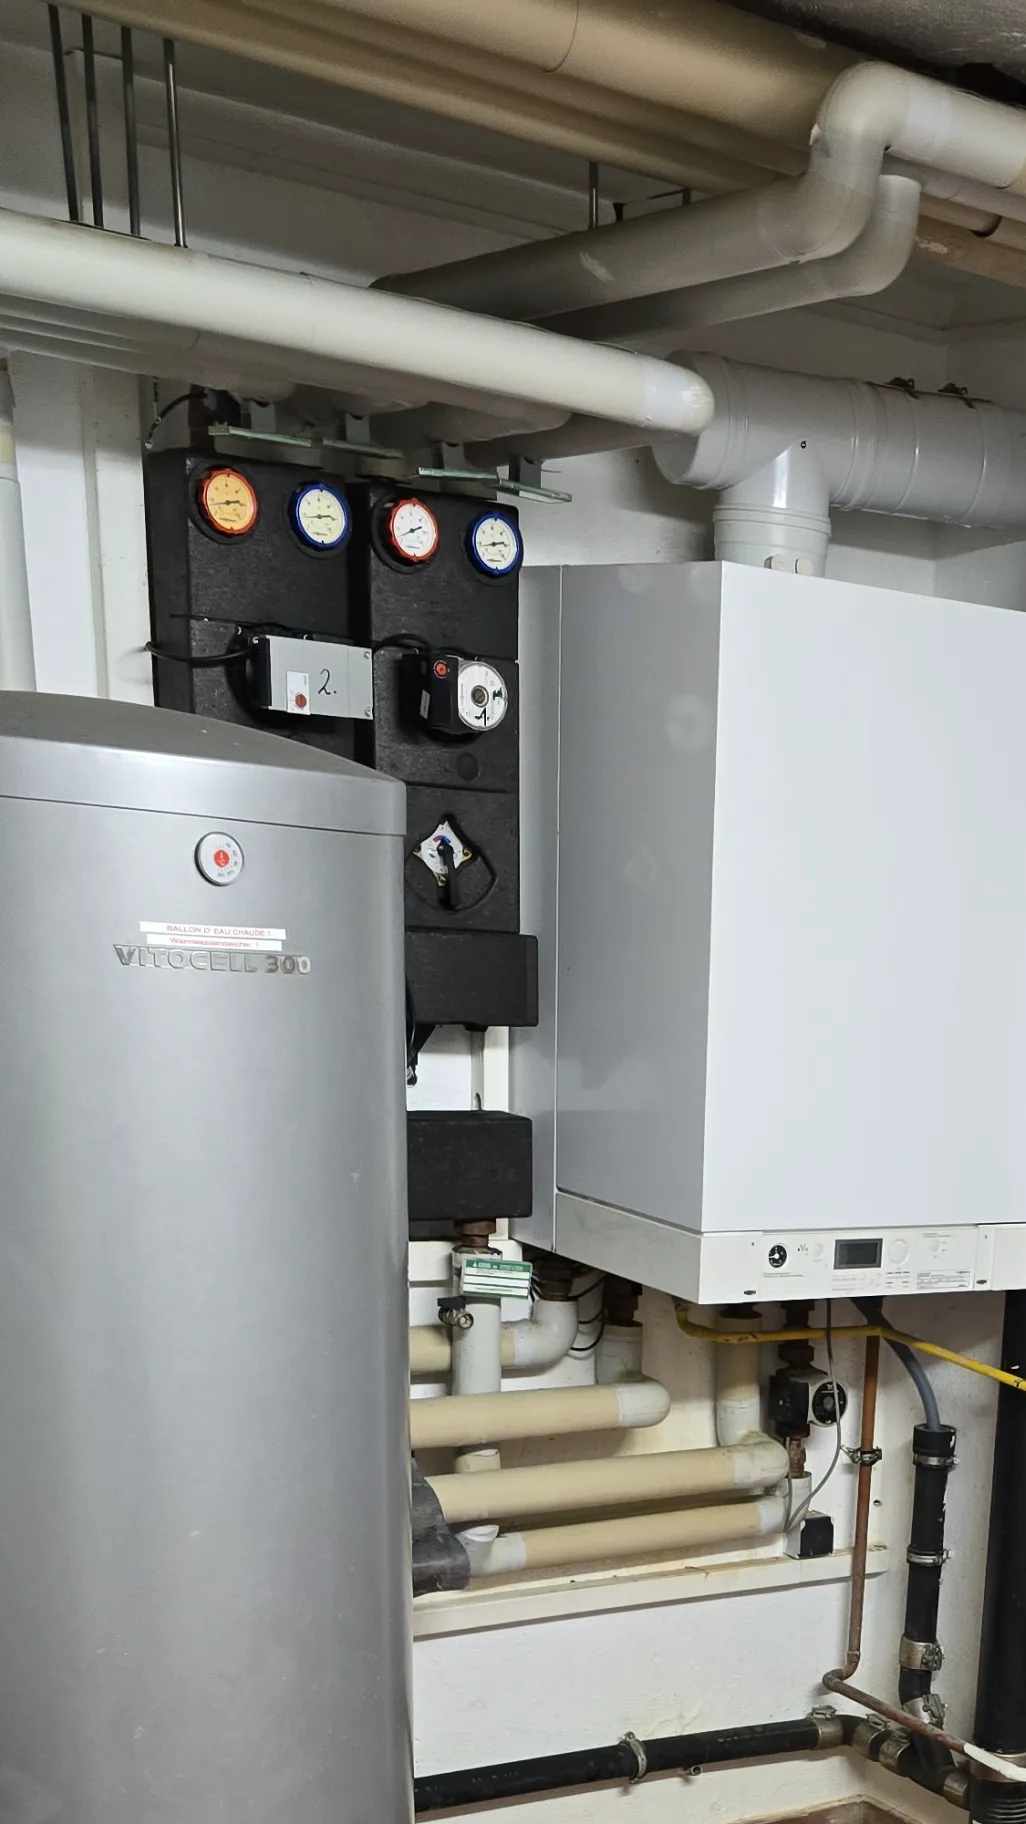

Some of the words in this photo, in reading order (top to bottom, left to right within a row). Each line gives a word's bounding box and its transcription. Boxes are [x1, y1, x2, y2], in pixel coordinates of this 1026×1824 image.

[166, 925, 201, 933] BALLON
[113, 944, 258, 972] VITOCELL
[265, 955, 311, 975] 300
